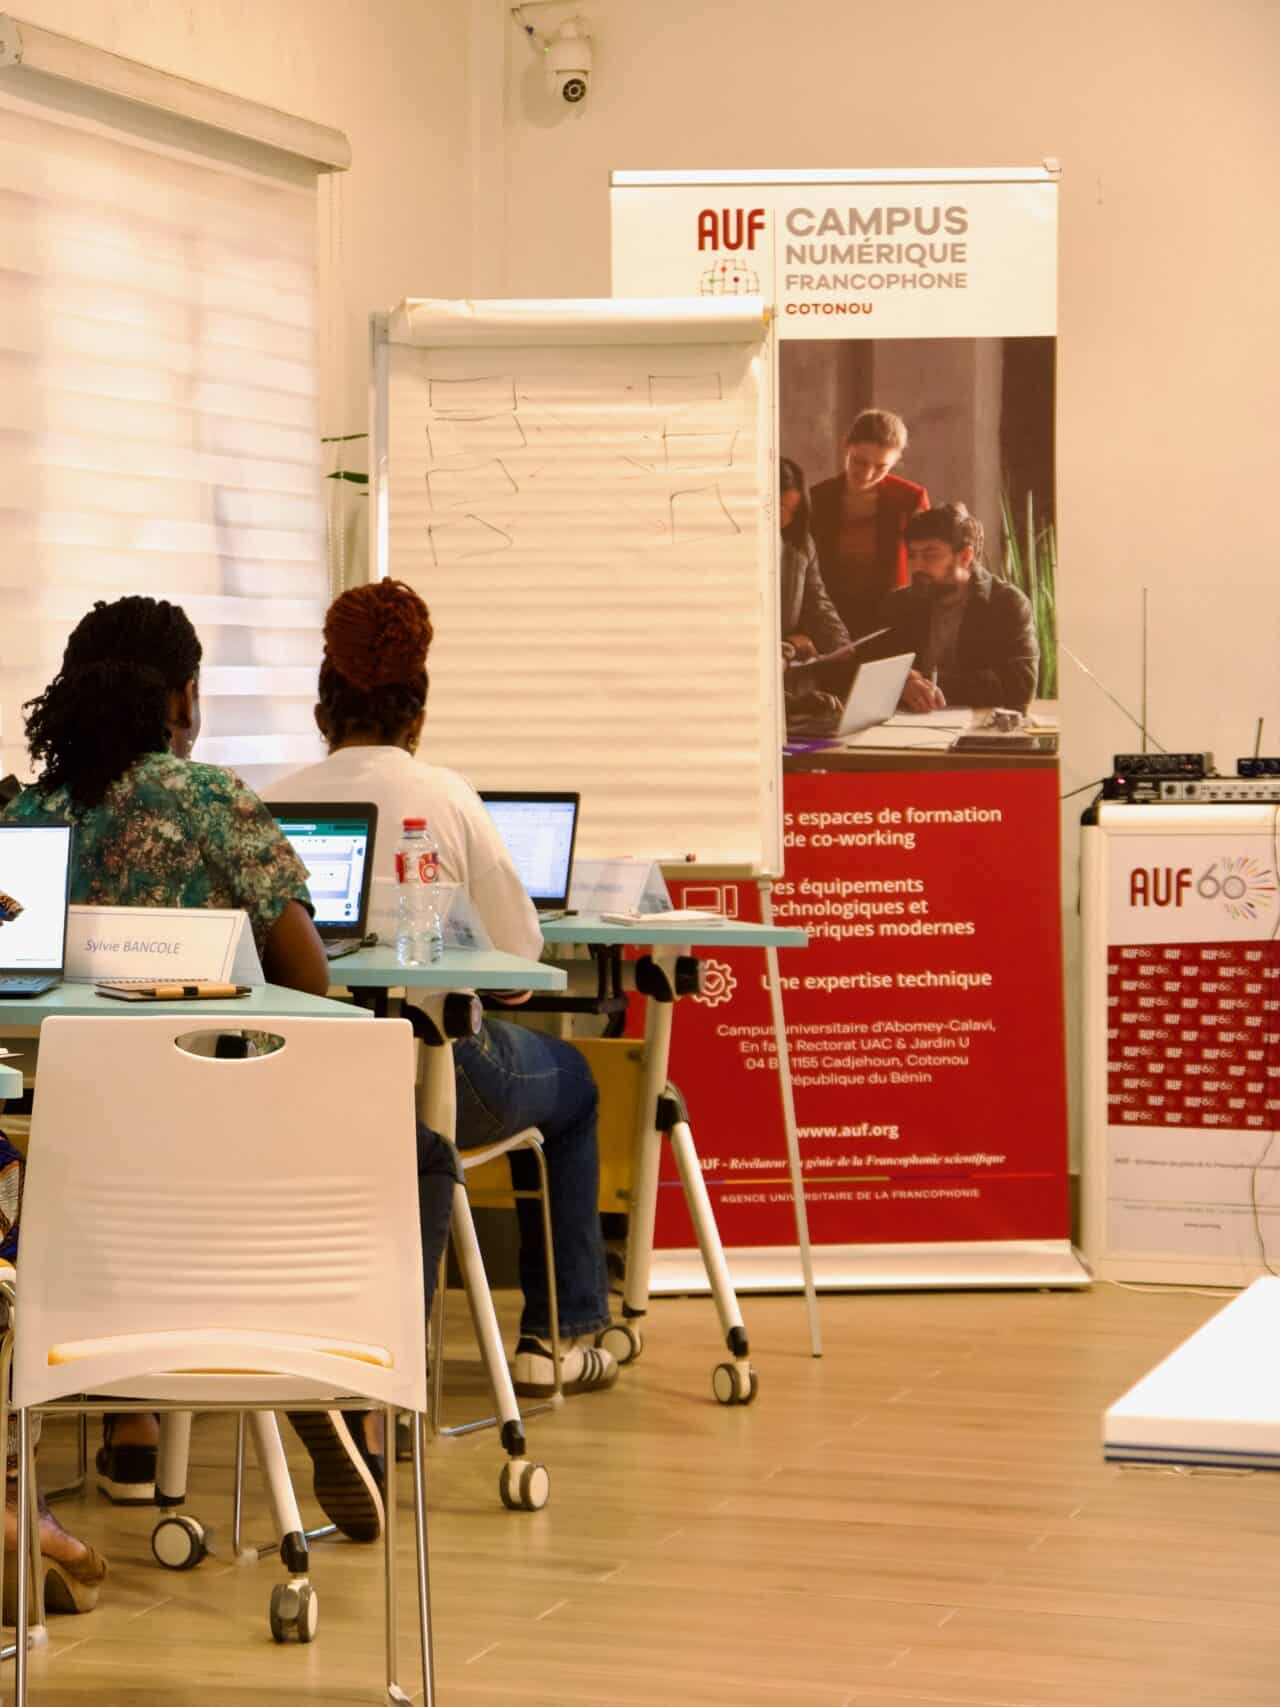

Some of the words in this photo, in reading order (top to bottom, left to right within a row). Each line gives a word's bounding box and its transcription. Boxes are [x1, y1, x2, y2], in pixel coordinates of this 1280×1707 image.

[698, 209, 765, 250] AUF
[785, 206, 968, 237] CAMPUS
[786, 238, 967, 268] NUMÉRIQUE
[786, 273, 967, 291] FRANCOPHONE
[785, 303, 872, 315] COTONOU
[798, 811, 873, 829] espaces
[878, 808, 901, 824] de
[906, 806, 1002, 824] formation
[784, 831, 806, 847] de
[812, 830, 916, 850] co-working
[800, 878, 924, 898] équipements
[770, 900, 905, 919] echnologiques
[909, 900, 928, 915] et
[880, 920, 976, 937] modernes
[85, 939, 120, 955] Sylvie
[123, 941, 182, 955] BANCOLE
[805, 972, 892, 992] expertise
[898, 970, 992, 990] technique
[717, 1024, 777, 1040] Campus
[740, 1042, 759, 1053] En
[763, 1041, 793, 1053] fae
[796, 1039, 856, 1051] Rectorat
[861, 1038, 893, 1050] UAC
[896, 1038, 907, 1050] &
[911, 1037, 956, 1050] Jardin
[745, 1057, 765, 1070] 04
[823, 1055, 903, 1071] Cadjehoun,
[907, 1053, 969, 1067] Cotonou
[791, 1072, 865, 1088] épublique
[869, 1071, 887, 1085] du
[891, 1070, 932, 1084] Bénin
[796, 1122, 899, 1140] www.auf.org
[837, 1155, 850, 1167] de
[852, 1155, 864, 1167] la
[867, 1153, 943, 1168] Francophonie
[720, 1193, 766, 1204] AGENCE
[769, 1190, 854, 1203] UNIVRSITAIRE
[858, 1190, 871, 1201] DE
[875, 1190, 889, 1200] LA
[893, 1188, 980, 1199] FRANCOPHONIE
